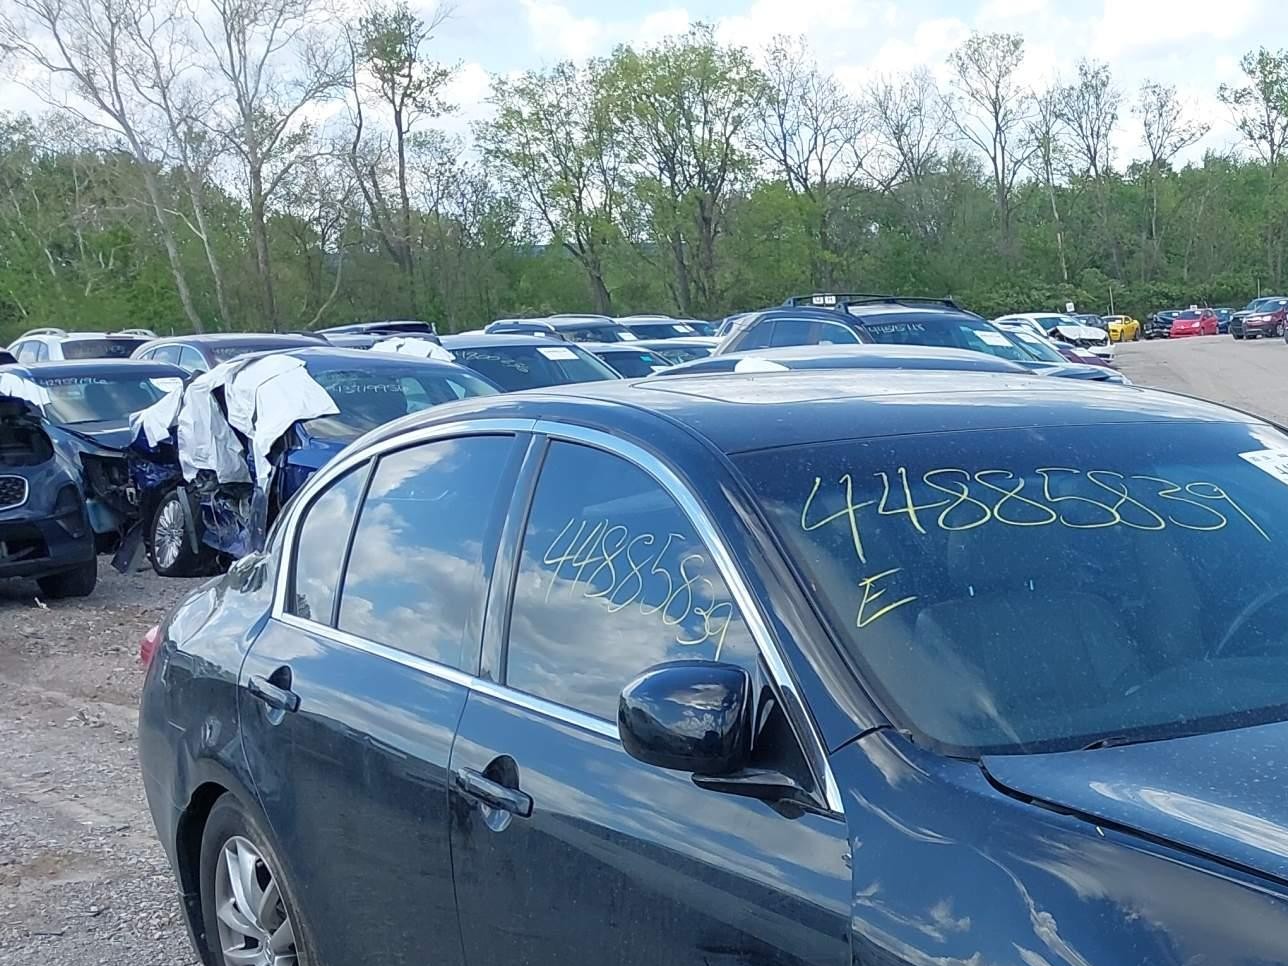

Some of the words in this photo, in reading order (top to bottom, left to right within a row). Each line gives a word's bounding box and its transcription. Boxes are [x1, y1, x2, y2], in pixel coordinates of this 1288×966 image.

[801, 465, 1271, 563] 44885839
[543, 518, 733, 661] 44885839
[856, 569, 916, 627] E
